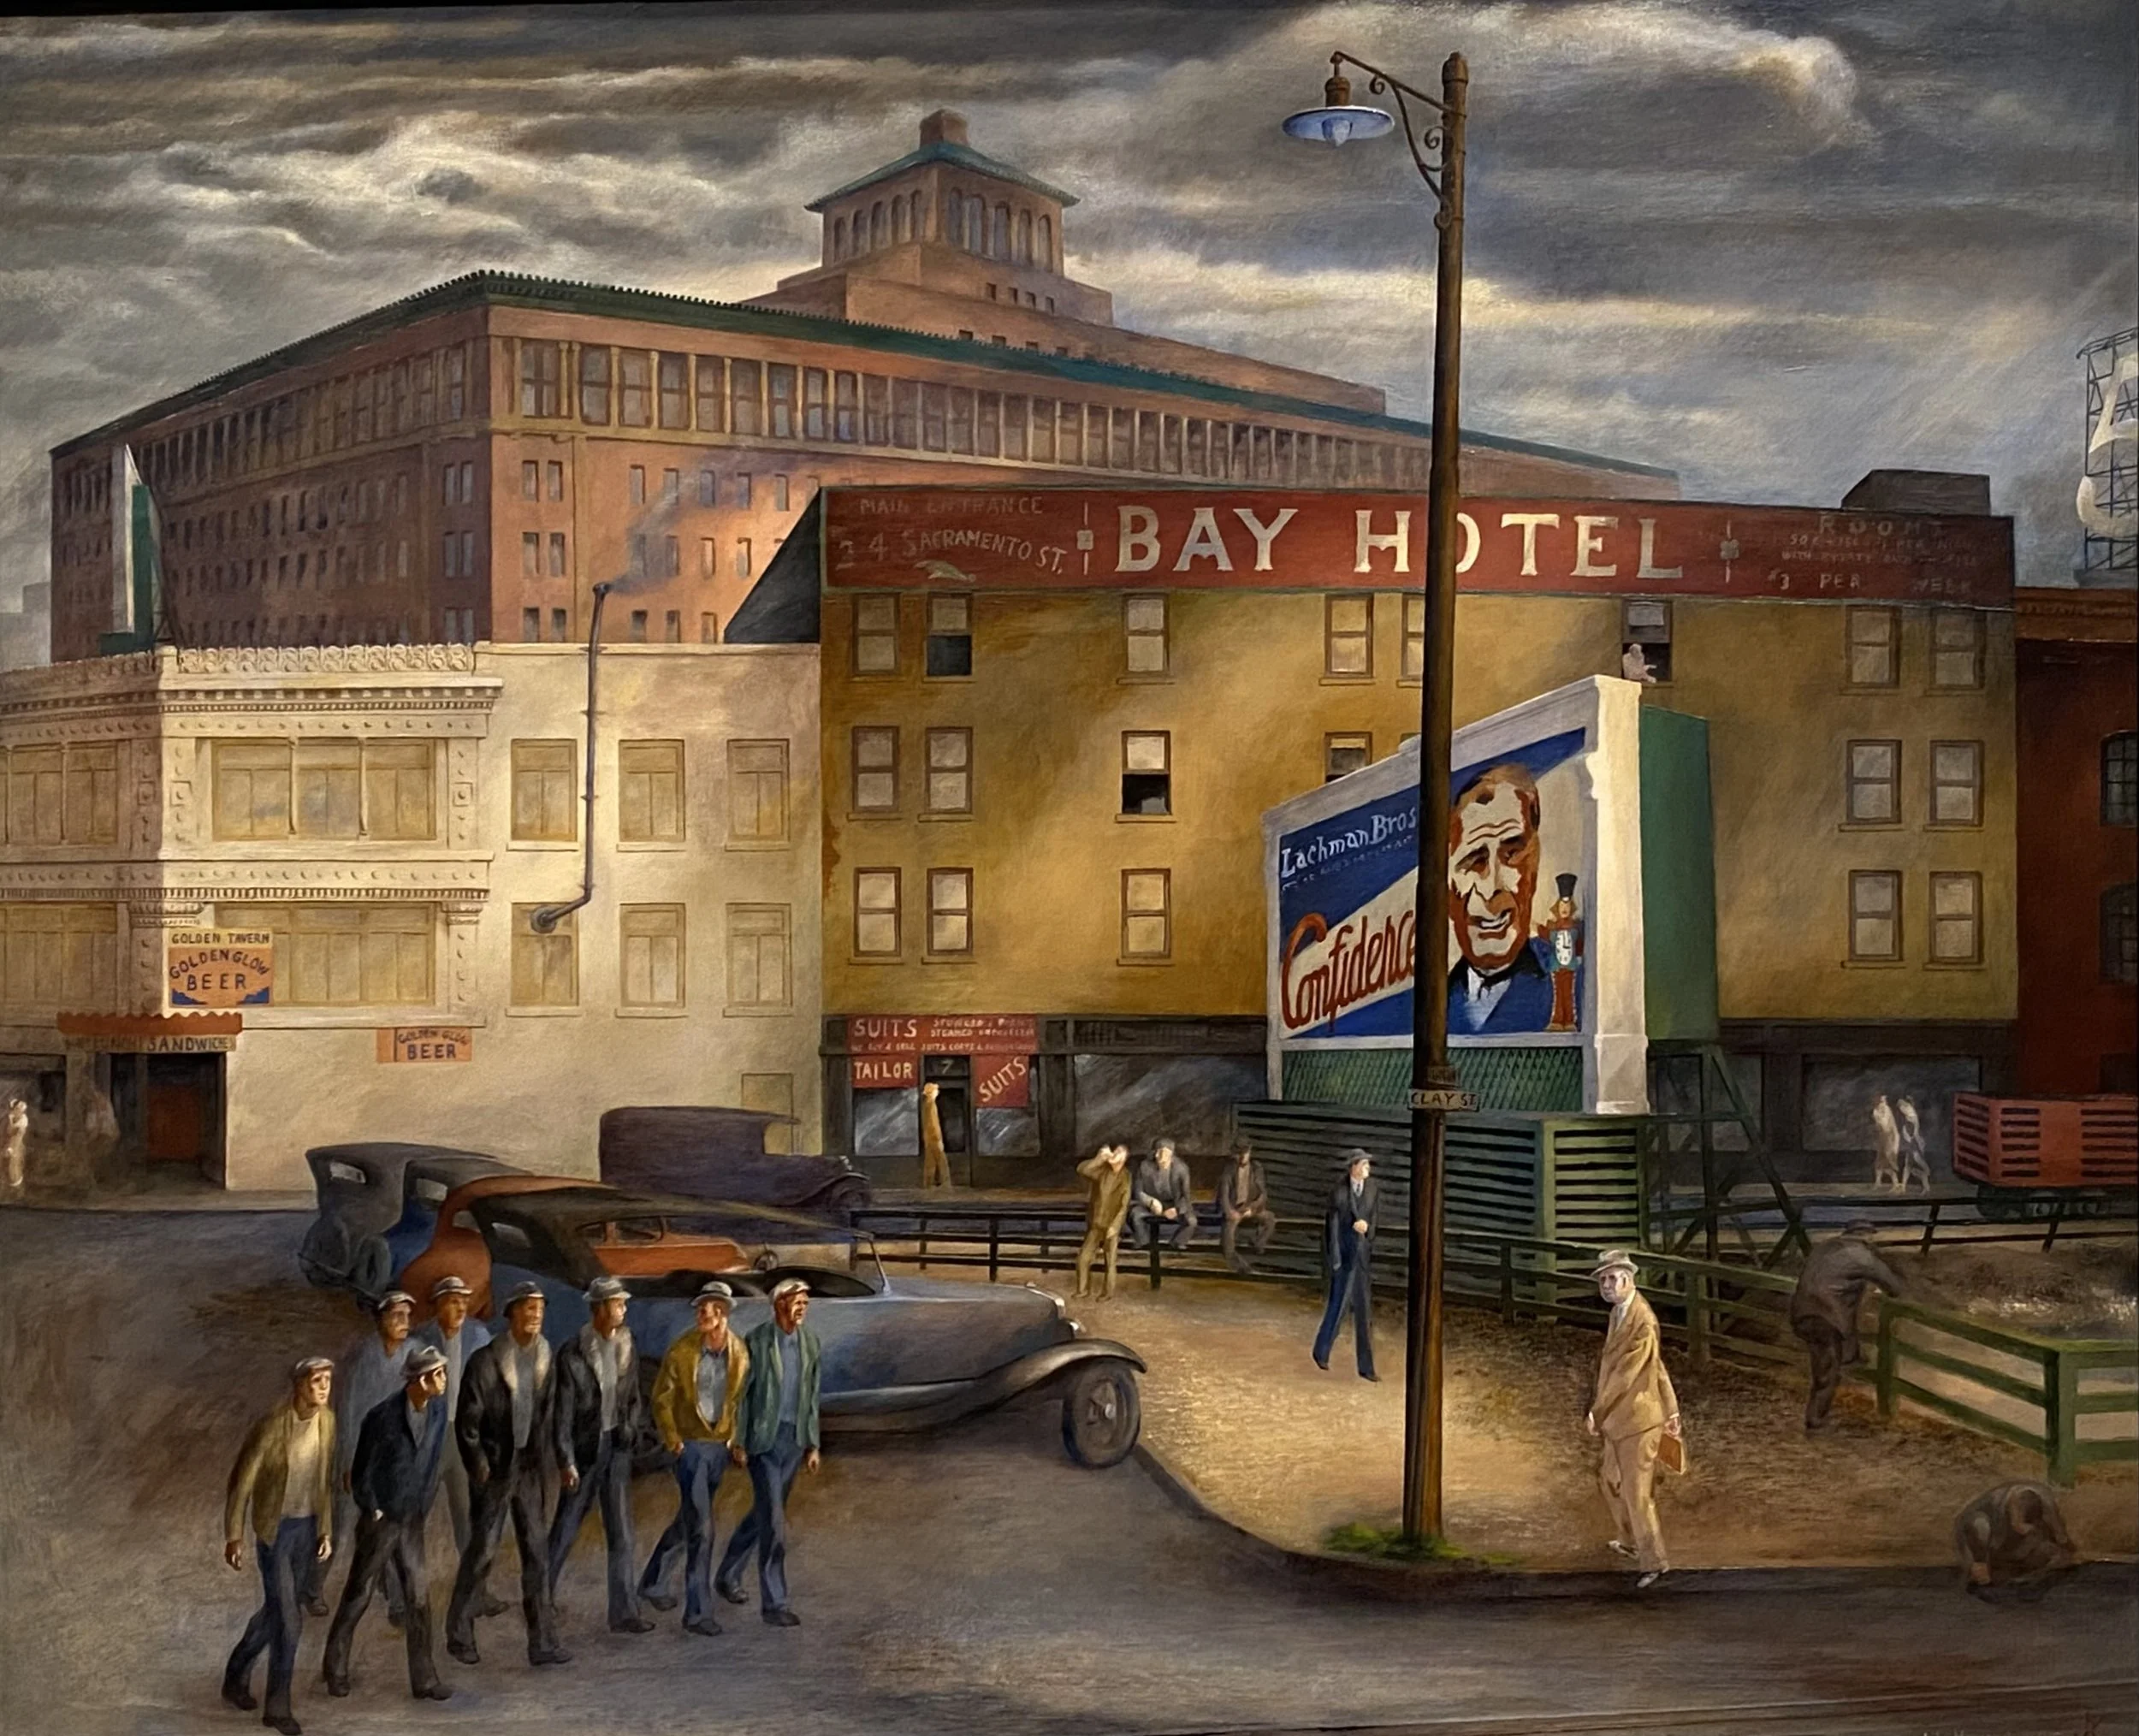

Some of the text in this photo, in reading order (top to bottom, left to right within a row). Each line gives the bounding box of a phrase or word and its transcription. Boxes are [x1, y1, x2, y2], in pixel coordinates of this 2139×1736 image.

[1114, 506, 1297, 572] BAY
[1034, 546, 1068, 576] ST.
[172, 933, 270, 945] GOLDEN TAVERN
[169, 949, 270, 980] GOLDEN GLOW
[187, 973, 246, 991] BEER
[854, 1019, 917, 1038] SUITS
[407, 1043, 456, 1060] BEER
[854, 1062, 913, 1080] TAILOR
[941, 1059, 954, 1075] 7
[978, 1056, 1028, 1103] SUITS
[1411, 1092, 1456, 1105] CLAY
